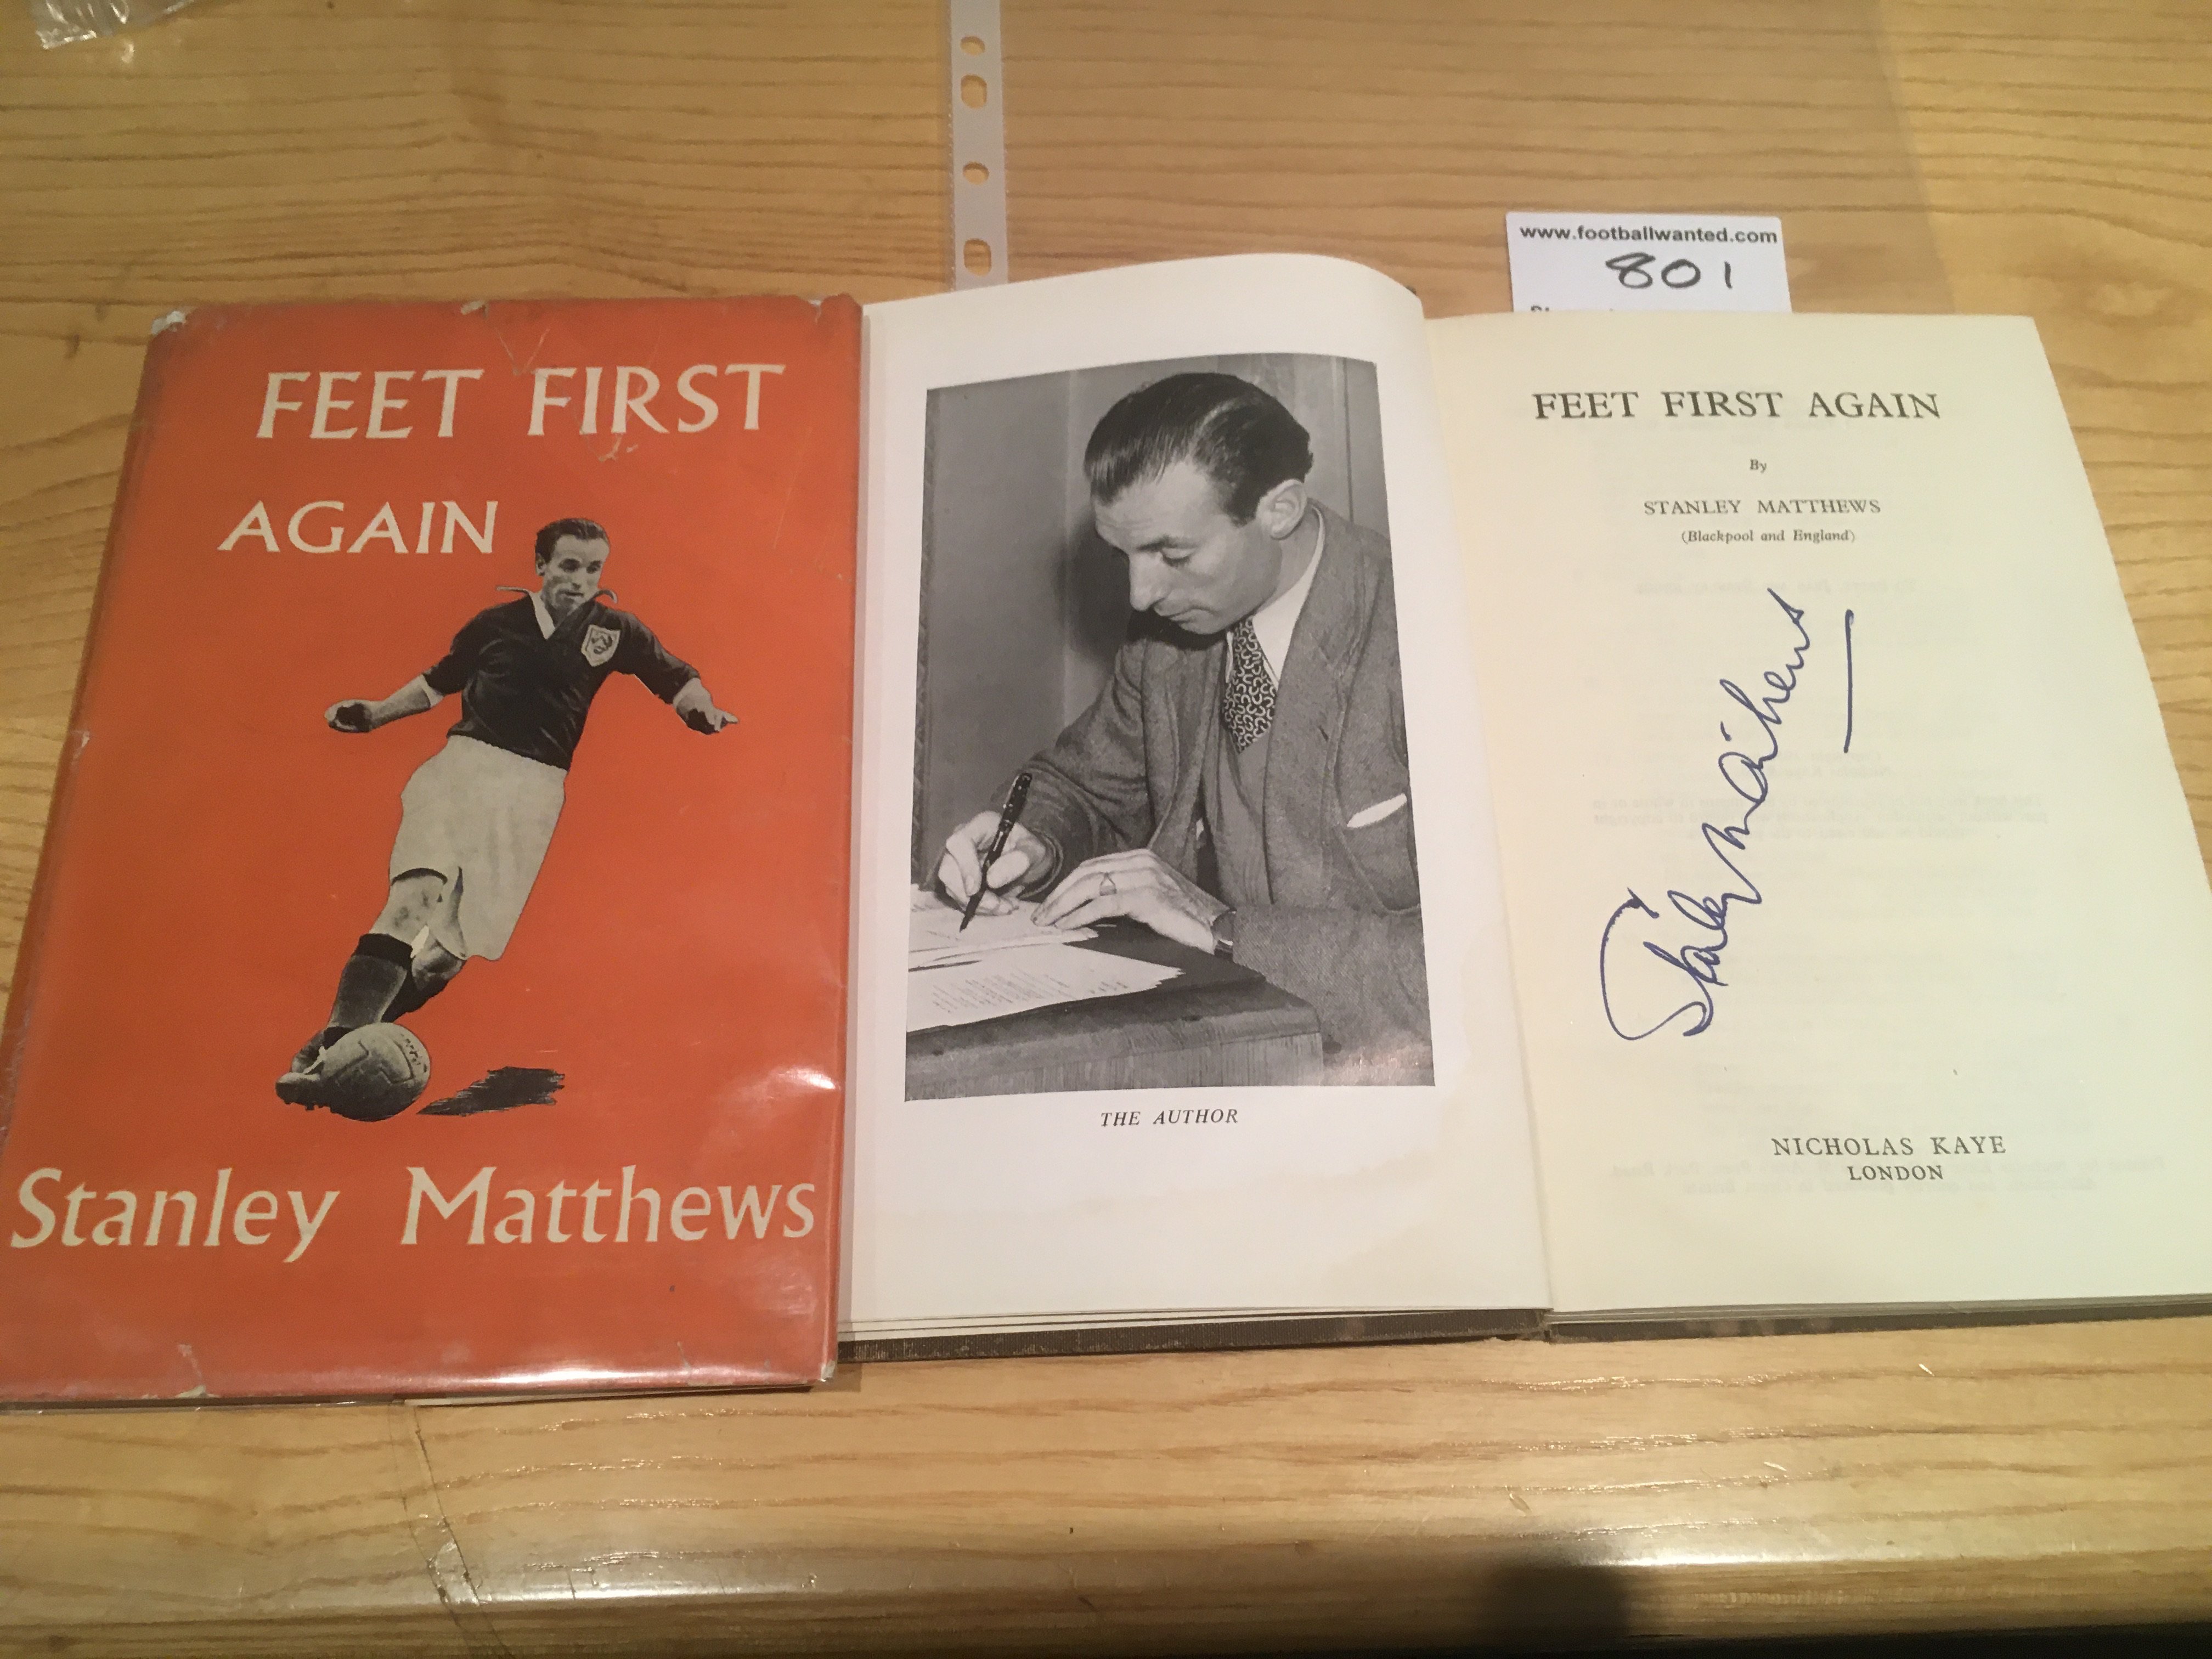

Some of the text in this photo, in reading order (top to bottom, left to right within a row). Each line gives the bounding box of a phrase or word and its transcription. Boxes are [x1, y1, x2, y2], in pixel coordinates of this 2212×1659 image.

[1519, 224, 1778, 244] www.footballwanted.com
[1605, 251, 1733, 290] 801
[256, 363, 785, 439] FEET FIRST
[1532, 391, 1941, 420] FEET FIRST AGAIN
[1749, 459, 1768, 474] By
[1643, 498, 1881, 515] STANLEY MATTHEWS
[217, 499, 499, 554] AGAIN
[1680, 528, 1856, 544] (Blackpool and England)
[1101, 1108, 1238, 1127] THE AUTHOR
[1771, 1135, 2007, 1156] NICHOLAS KAYE
[1847, 1164, 1944, 1181] LONDON
[10, 1164, 816, 1263] Stanley Matthews
